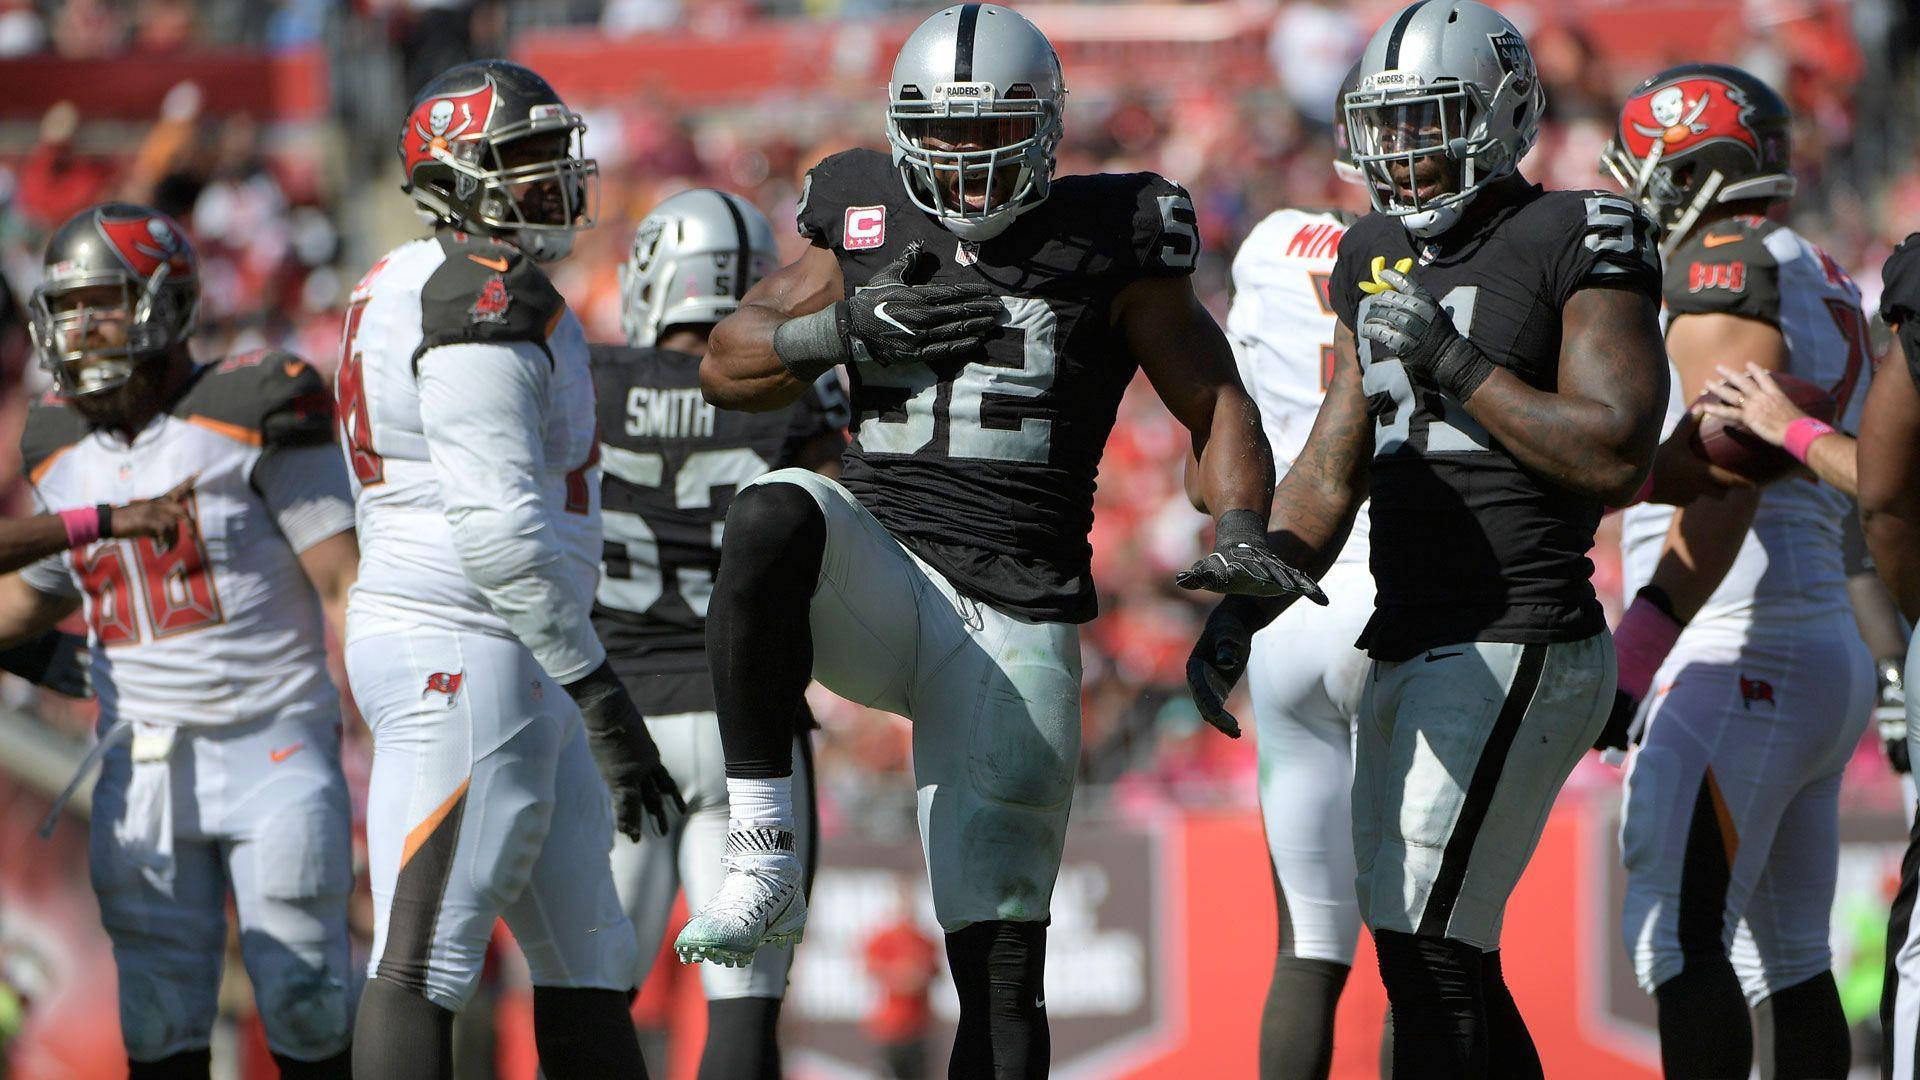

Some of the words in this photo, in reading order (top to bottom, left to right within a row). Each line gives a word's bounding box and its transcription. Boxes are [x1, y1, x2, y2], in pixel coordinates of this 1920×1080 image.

[1377, 75, 1404, 84] RAIDERS
[947, 86, 979, 96] RAIDERS
[849, 210, 883, 238] C
[625, 386, 716, 438] SMITH
